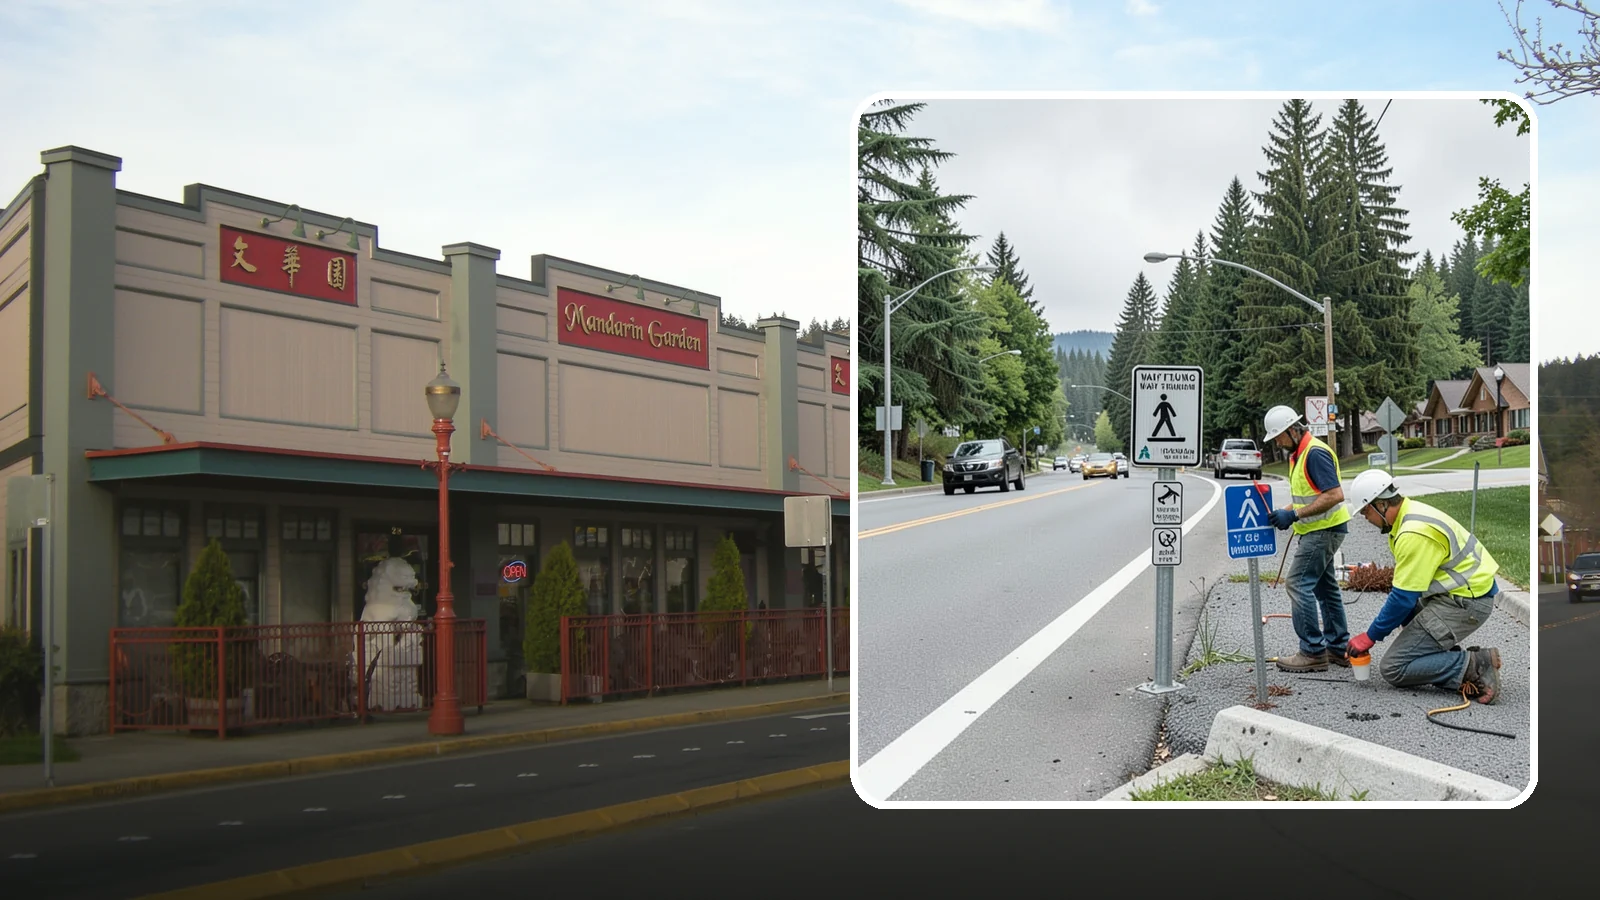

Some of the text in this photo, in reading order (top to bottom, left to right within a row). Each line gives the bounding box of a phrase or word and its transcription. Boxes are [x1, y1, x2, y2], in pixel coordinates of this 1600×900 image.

[230, 235, 346, 291] 文華園
[564, 302, 701, 352] Mandarin Garden
[503, 565, 527, 578] OPEN
